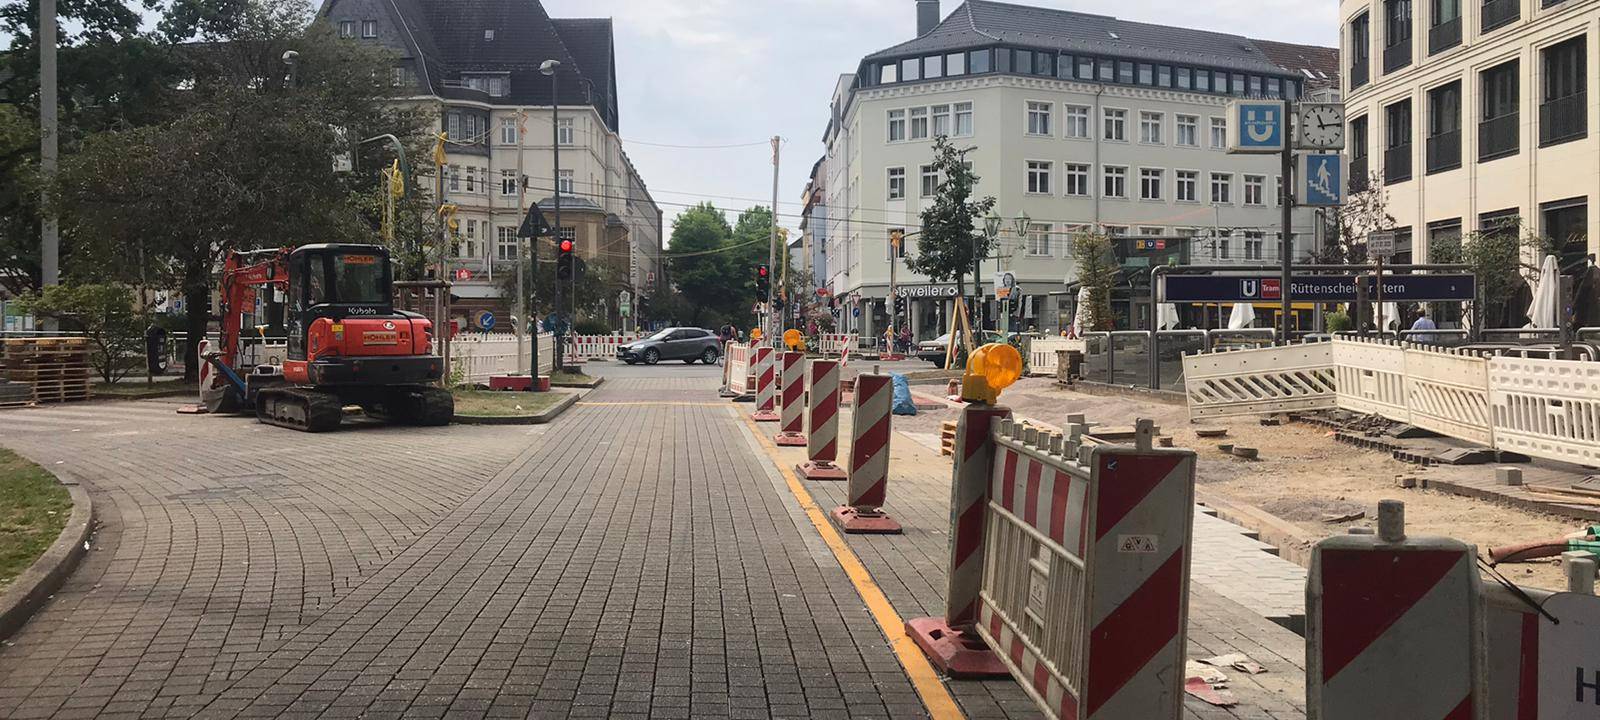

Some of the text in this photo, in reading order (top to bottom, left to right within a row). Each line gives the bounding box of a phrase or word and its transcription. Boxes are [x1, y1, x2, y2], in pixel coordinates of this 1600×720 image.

[1243, 280, 1256, 296] U
[1290, 282, 1374, 294] Rüttenscheir
[1381, 283, 1405, 294] tern
